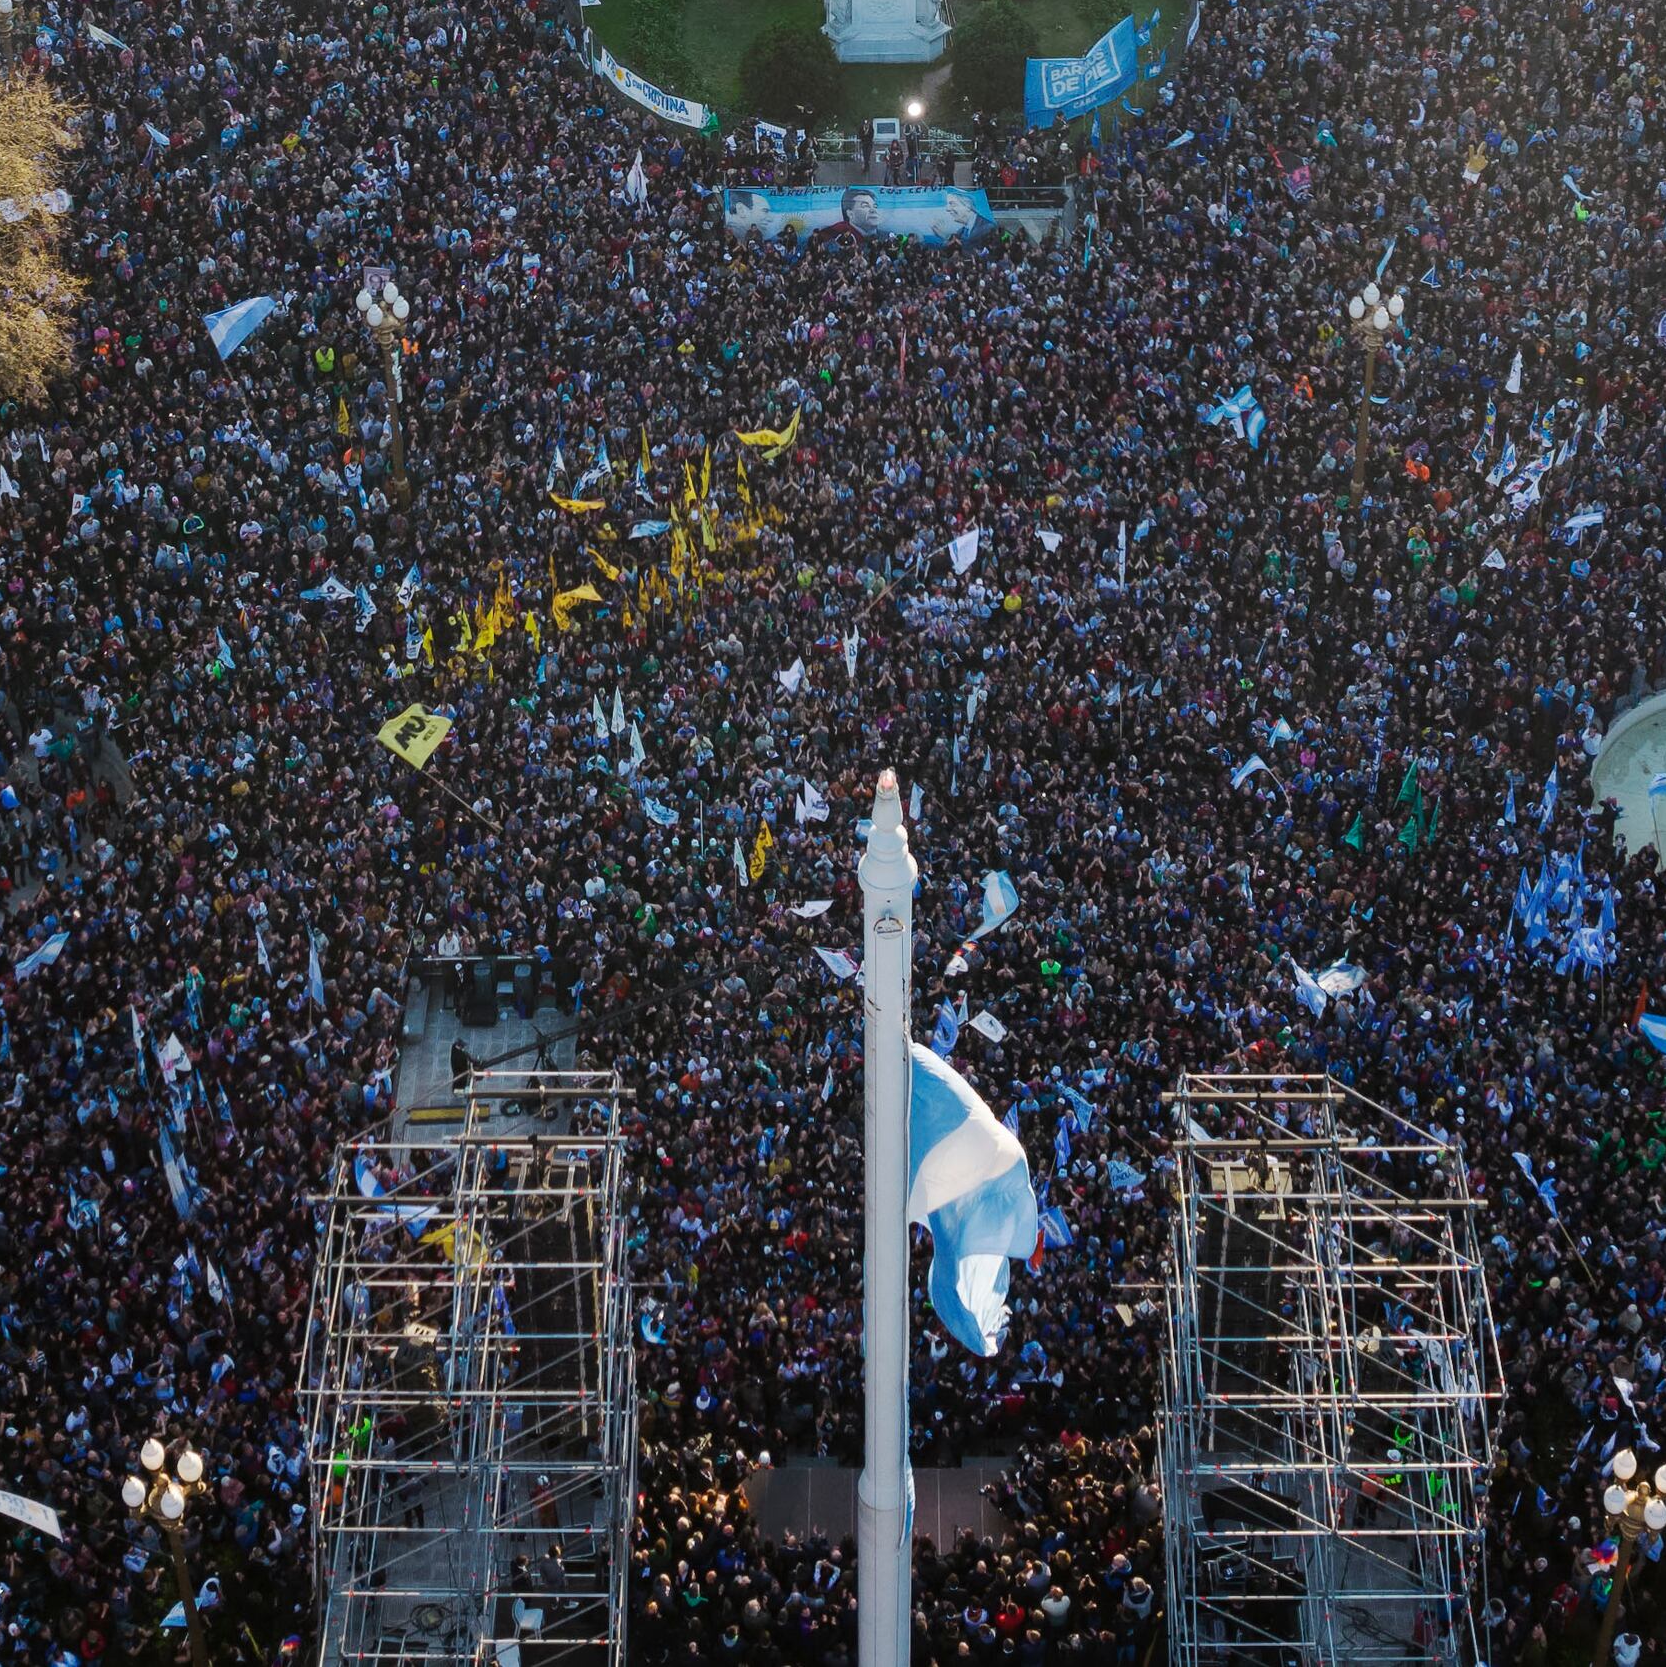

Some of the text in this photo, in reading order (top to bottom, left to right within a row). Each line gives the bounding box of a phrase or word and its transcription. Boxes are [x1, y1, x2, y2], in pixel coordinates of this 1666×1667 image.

[1051, 60, 1110, 97] DE PIE
[643, 83, 689, 115] CRISTINA
